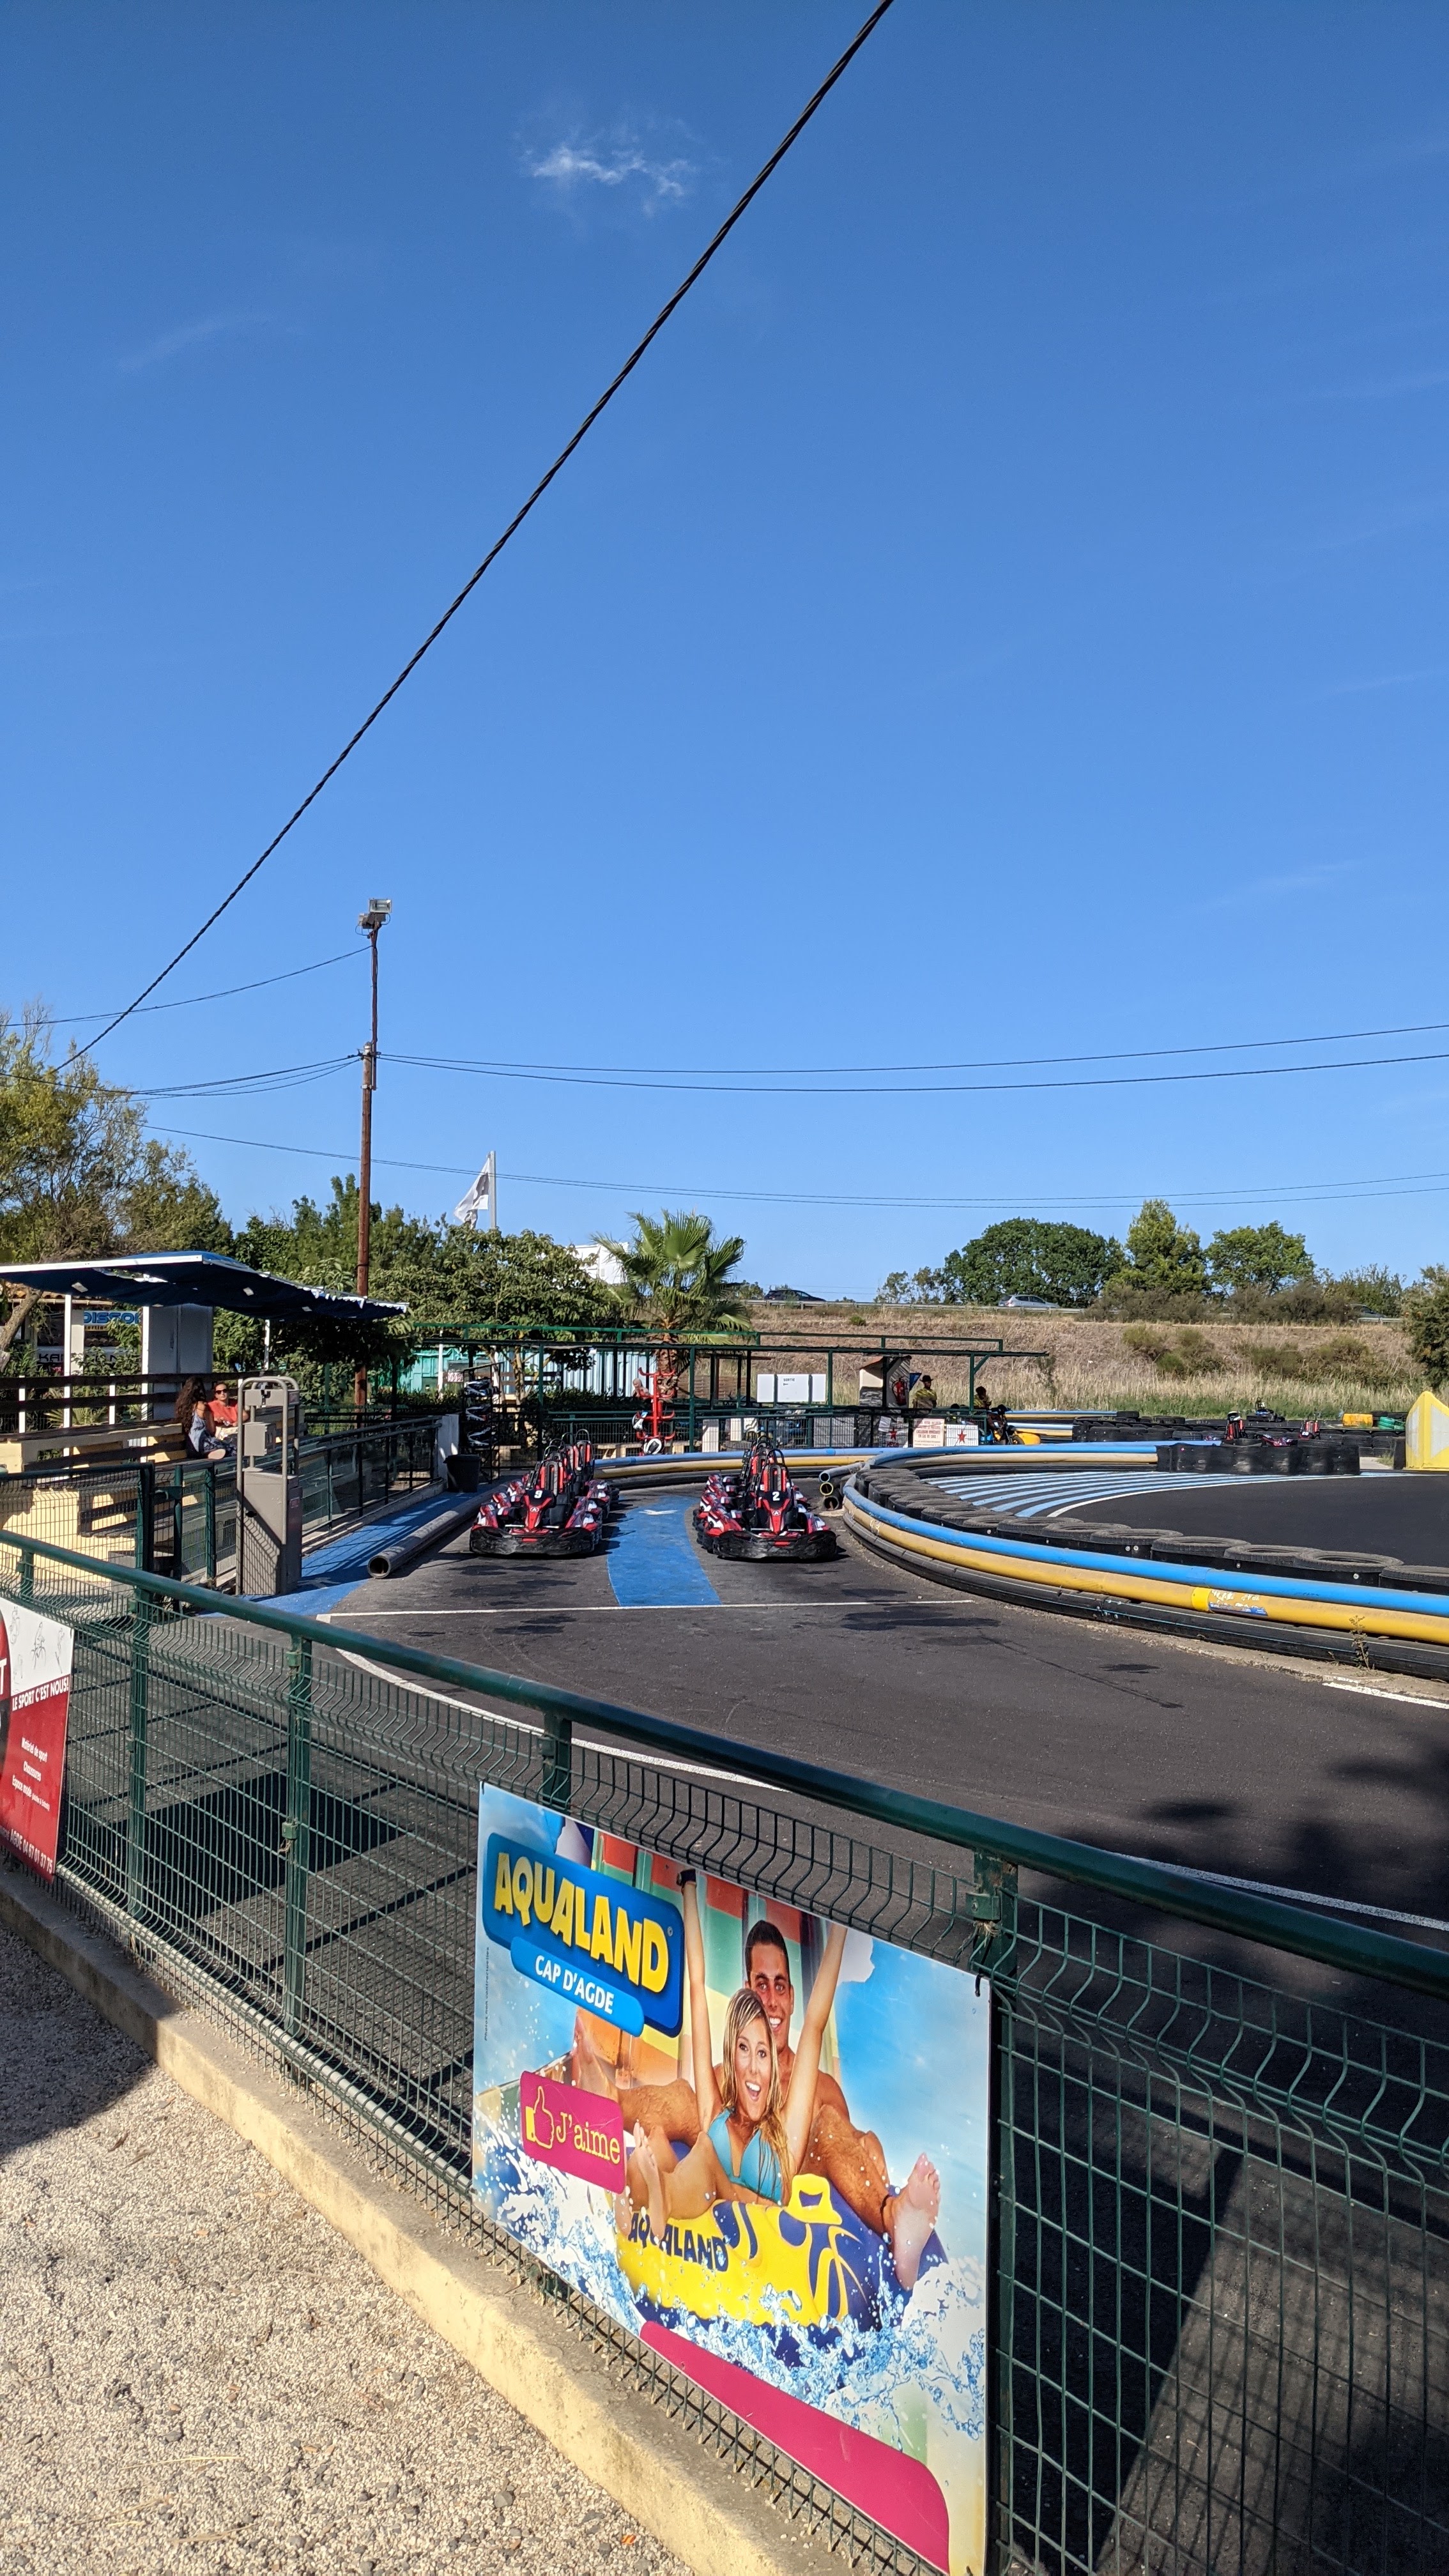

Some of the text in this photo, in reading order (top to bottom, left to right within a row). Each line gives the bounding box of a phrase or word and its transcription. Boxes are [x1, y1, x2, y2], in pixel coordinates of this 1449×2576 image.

[534, 1490, 543, 1499] 9
[772, 1491, 780, 1501] 2
[12, 1676, 69, 1712] LE SPORT C'EST NOUS!
[34, 1745, 39, 1758] de
[38, 1750, 48, 1763] sport
[12, 1774, 23, 1791] Espace
[10, 1828, 23, 1851] AGDE
[22, 1839, 29, 1855] 04
[28, 1843, 34, 1859] 67
[34, 1848, 40, 1864] 01
[40, 1852, 47, 1869] 37
[46, 1857, 53, 1874] 75
[494, 1852, 669, 1993] AQUALAND
[535, 1955, 615, 2015] CAP D'AGDE
[555, 2112, 621, 2165] J'aime
[627, 2212, 729, 2273] AQALAND
